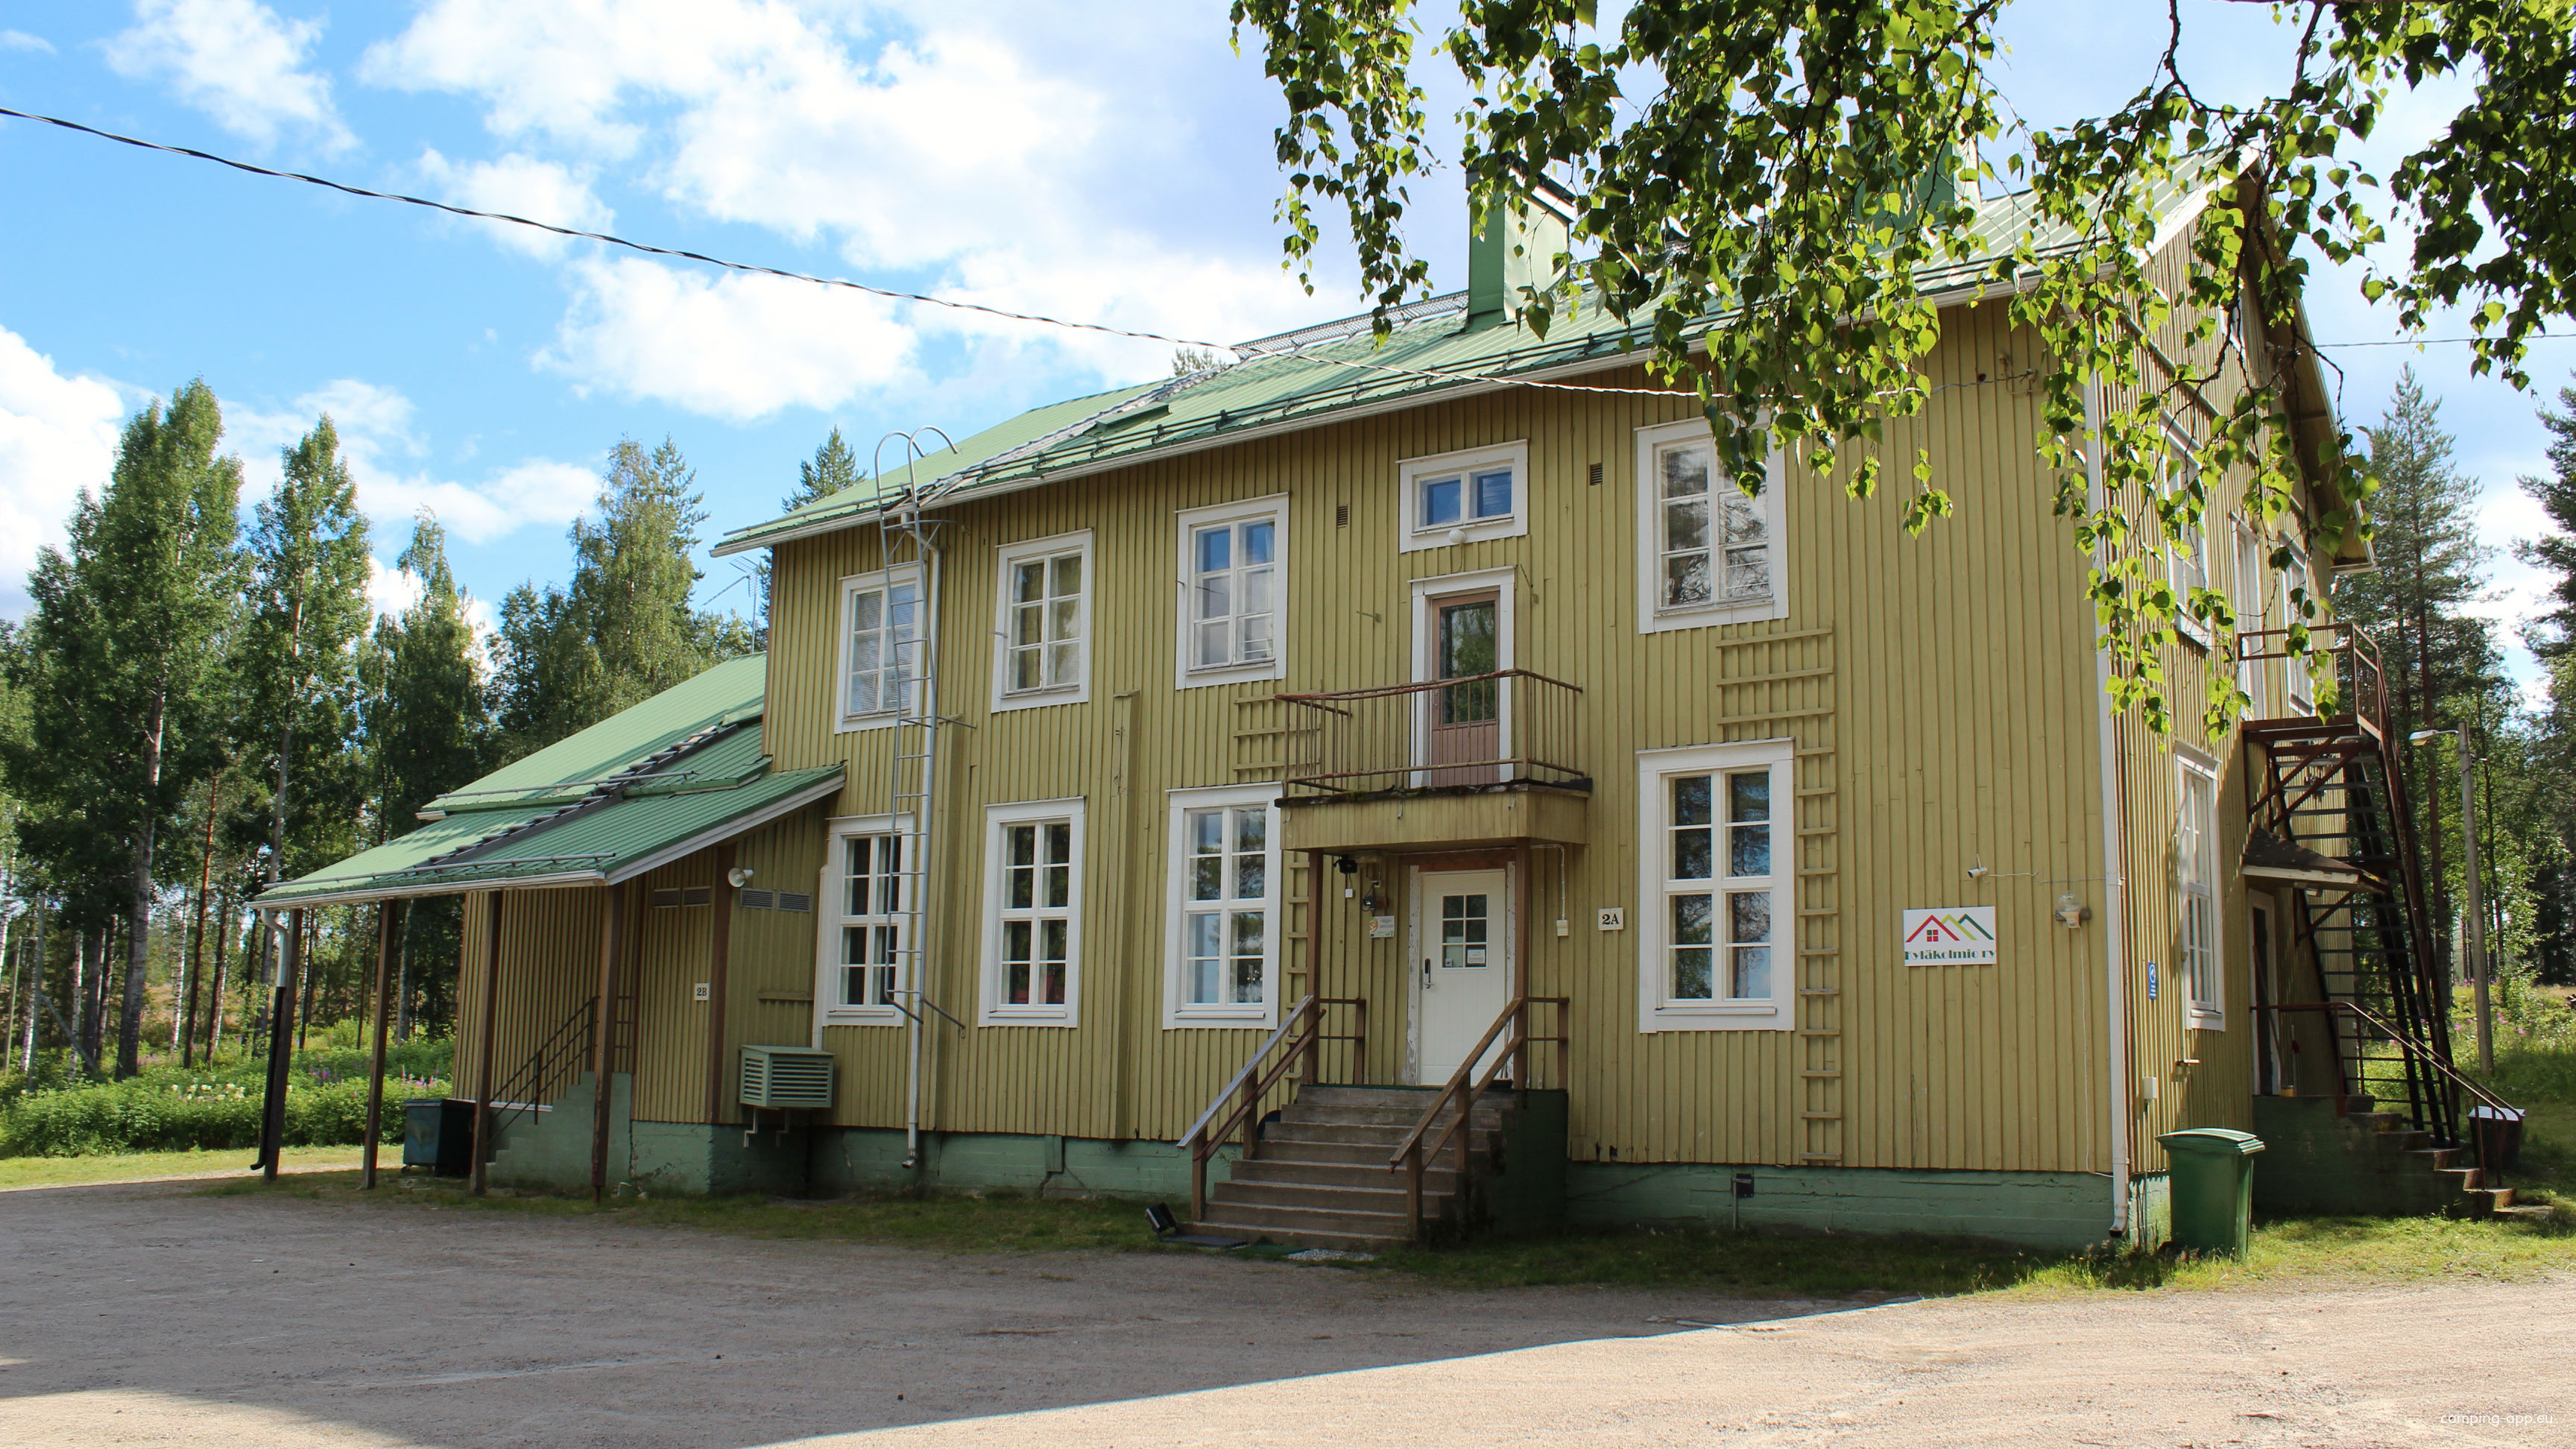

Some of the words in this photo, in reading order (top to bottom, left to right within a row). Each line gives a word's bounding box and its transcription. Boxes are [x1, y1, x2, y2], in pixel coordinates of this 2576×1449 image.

[1602, 913, 1620, 925] 2A
[1982, 950, 1996, 959] ry
[696, 987, 707, 997] 2B
